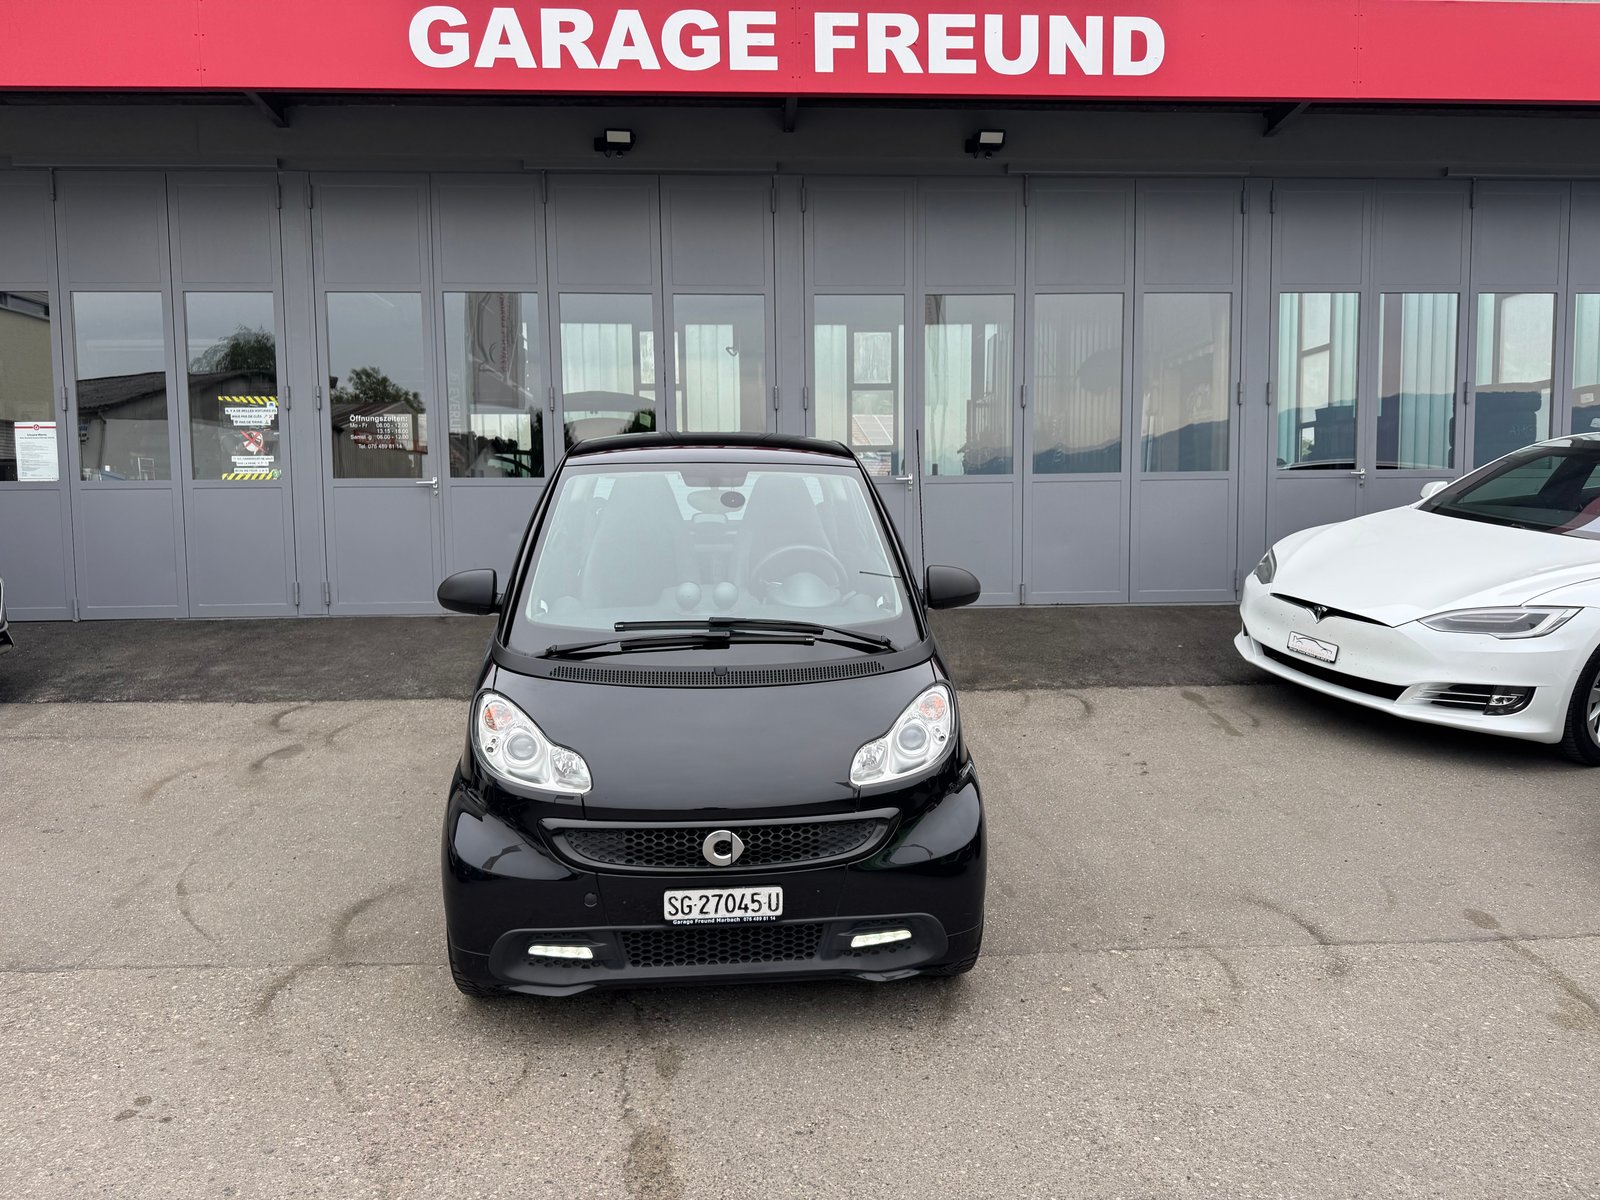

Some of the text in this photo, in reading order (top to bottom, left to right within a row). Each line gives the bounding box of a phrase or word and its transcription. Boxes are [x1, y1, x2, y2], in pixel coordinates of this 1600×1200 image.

[408, 5, 1166, 77] GARAGE FREUND
[349, 414, 408, 423] Öffnungszeiten:
